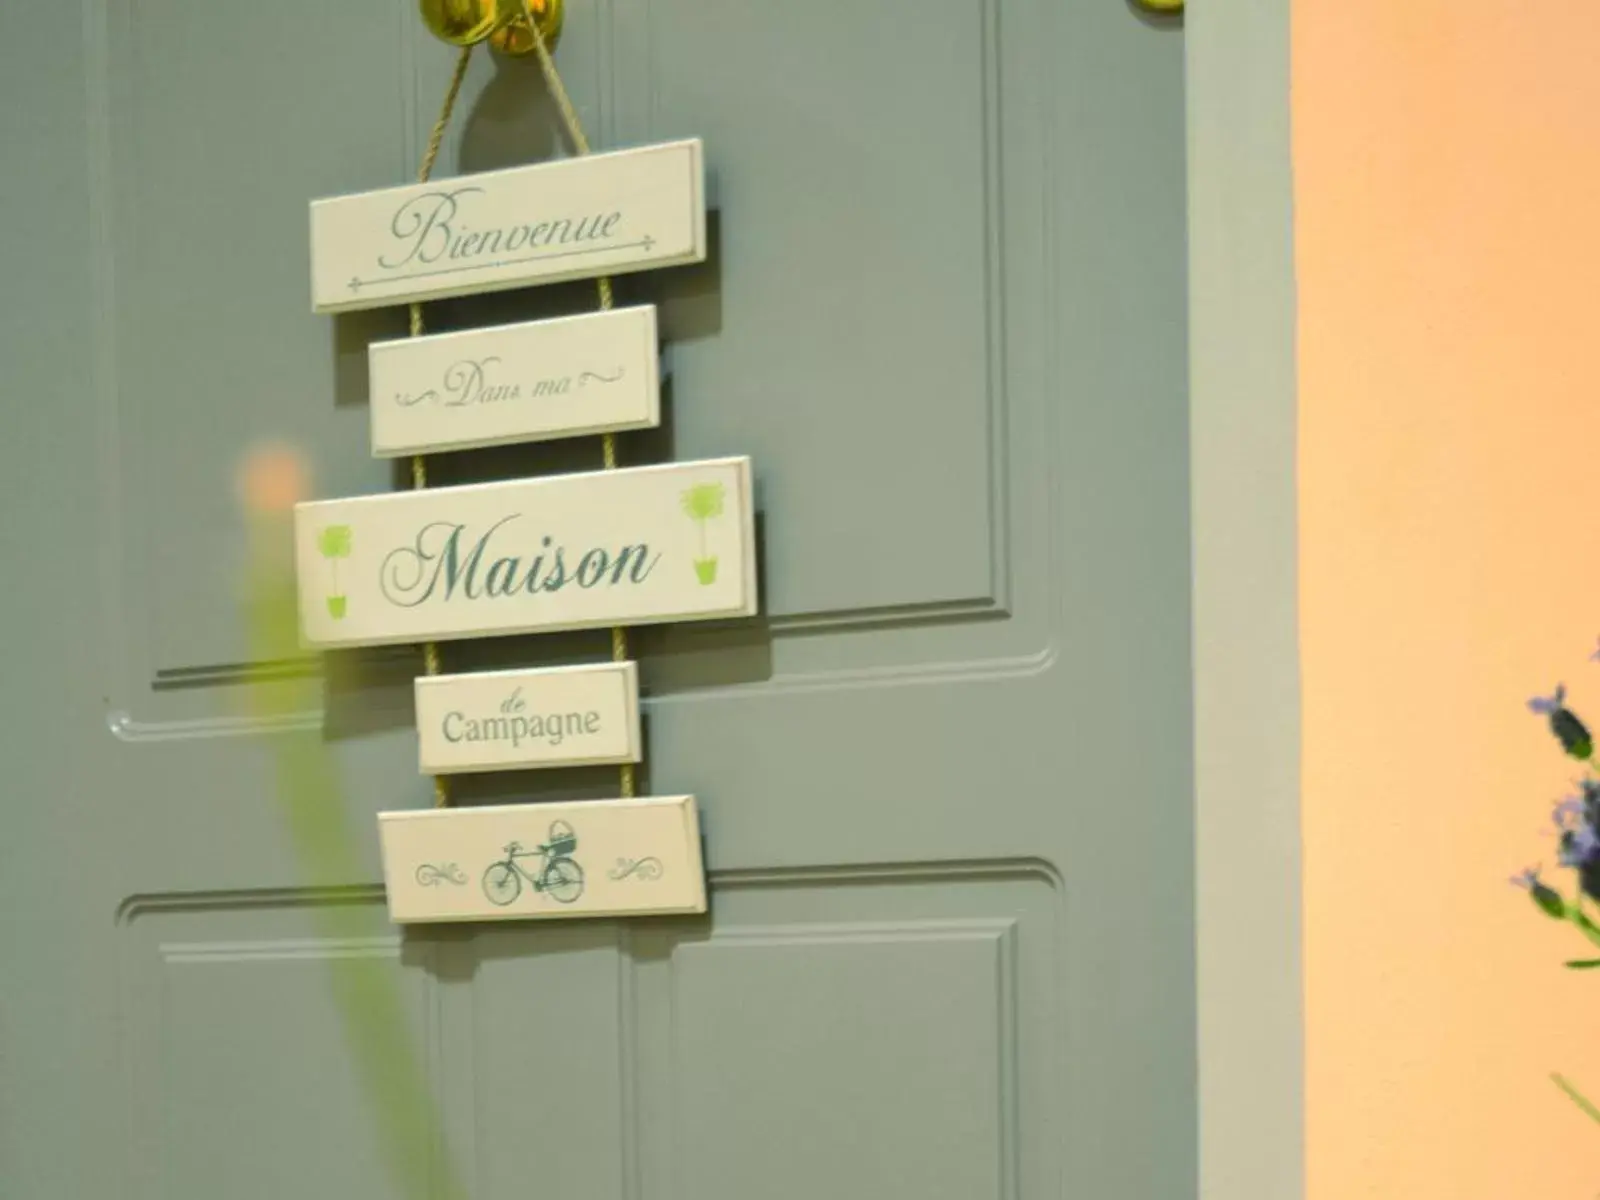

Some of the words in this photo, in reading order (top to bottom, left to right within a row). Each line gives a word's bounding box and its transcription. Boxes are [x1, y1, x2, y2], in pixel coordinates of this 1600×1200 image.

[377, 186, 622, 270] Bienvenue
[444, 356, 521, 408] Dans
[532, 375, 572, 398] ma
[380, 512, 662, 608] Maison
[500, 686, 527, 715] de
[441, 707, 601, 748] Campagne
